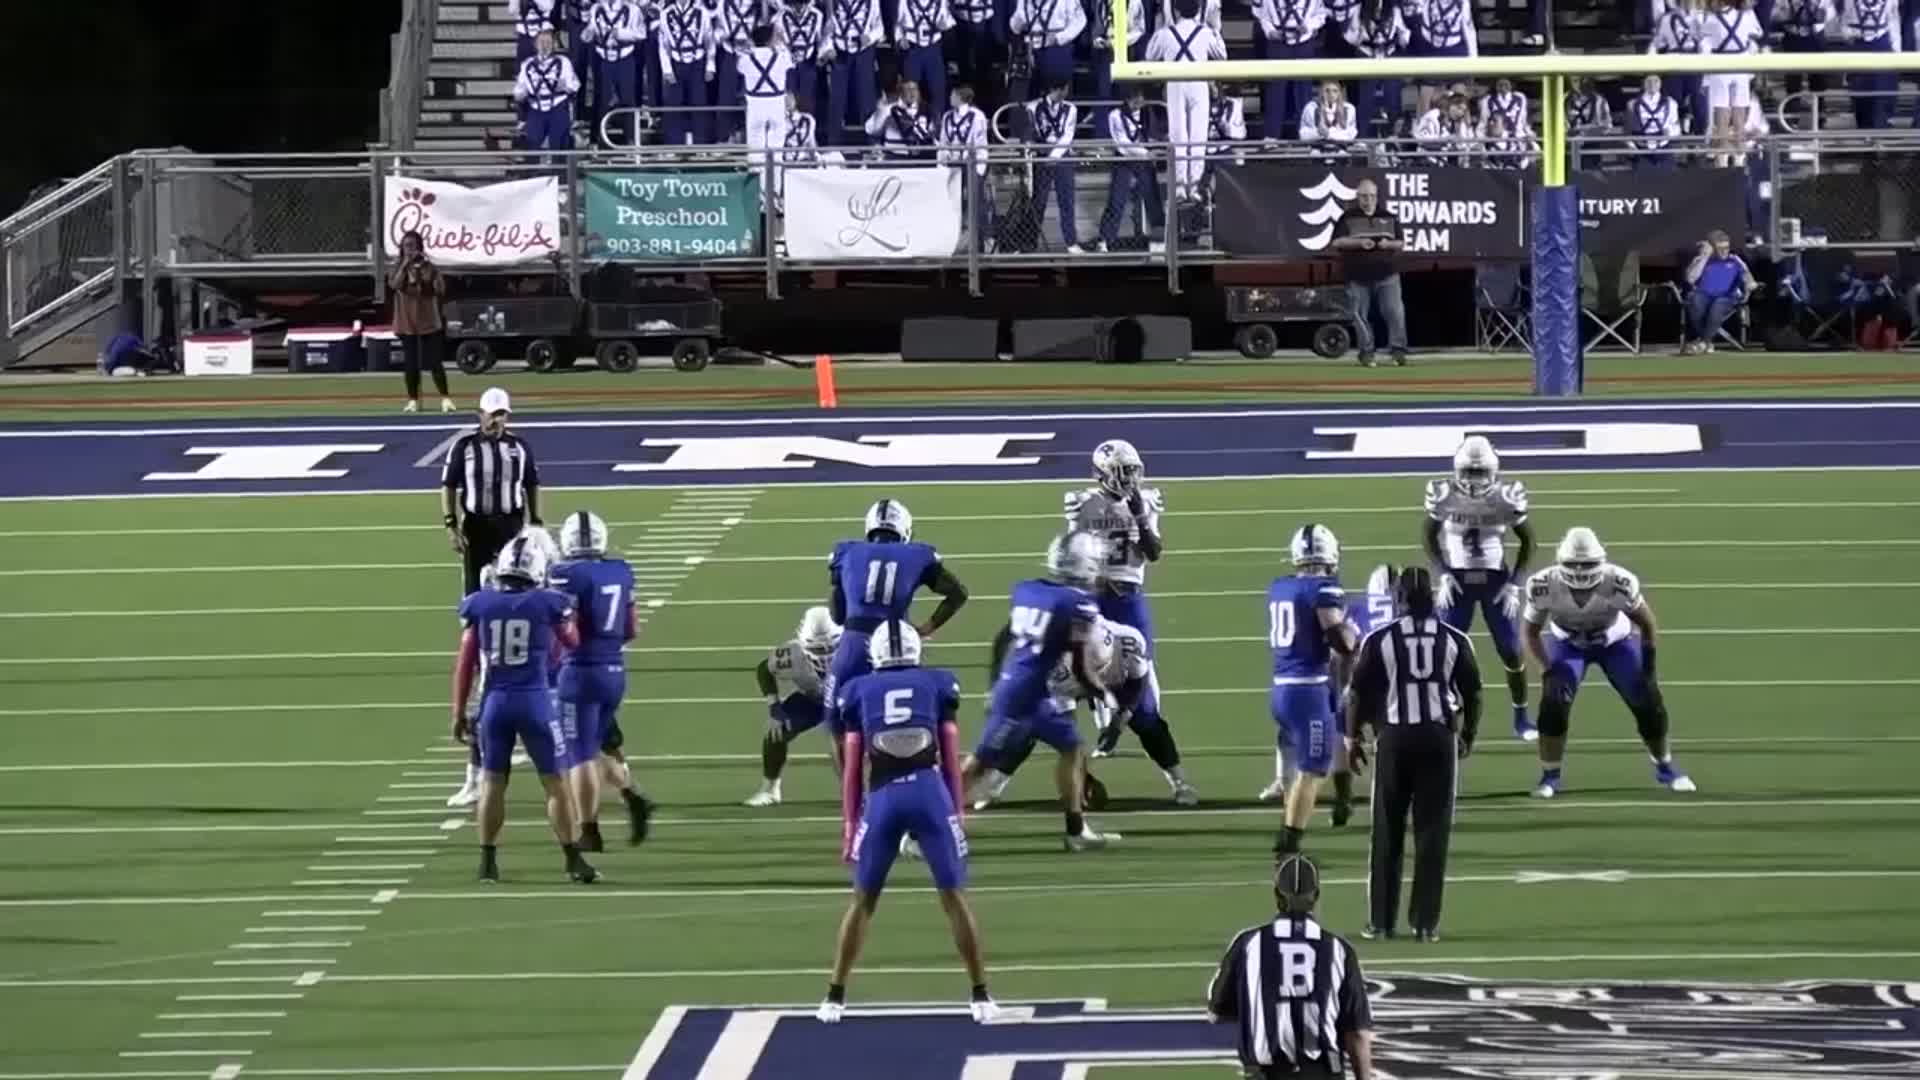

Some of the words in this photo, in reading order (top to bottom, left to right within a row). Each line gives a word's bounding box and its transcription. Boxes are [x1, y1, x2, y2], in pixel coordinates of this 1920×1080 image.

[615, 178, 659, 201] Toy
[663, 178, 728, 197] Town
[1385, 173, 1429, 197] THE
[615, 205, 729, 226] Preschool
[1386, 200, 1497, 225] EDWARDS
[1642, 197, 1661, 214] 21
[607, 238, 737, 254] 903-881-9404
[1402, 228, 1450, 252] EAM
[864, 560, 898, 604] 11
[602, 584, 622, 631] 7
[1269, 601, 1294, 648] 10
[489, 619, 531, 665] 18
[775, 647, 792, 669] 53
[1405, 637, 1435, 680] U
[1279, 942, 1316, 997] B
